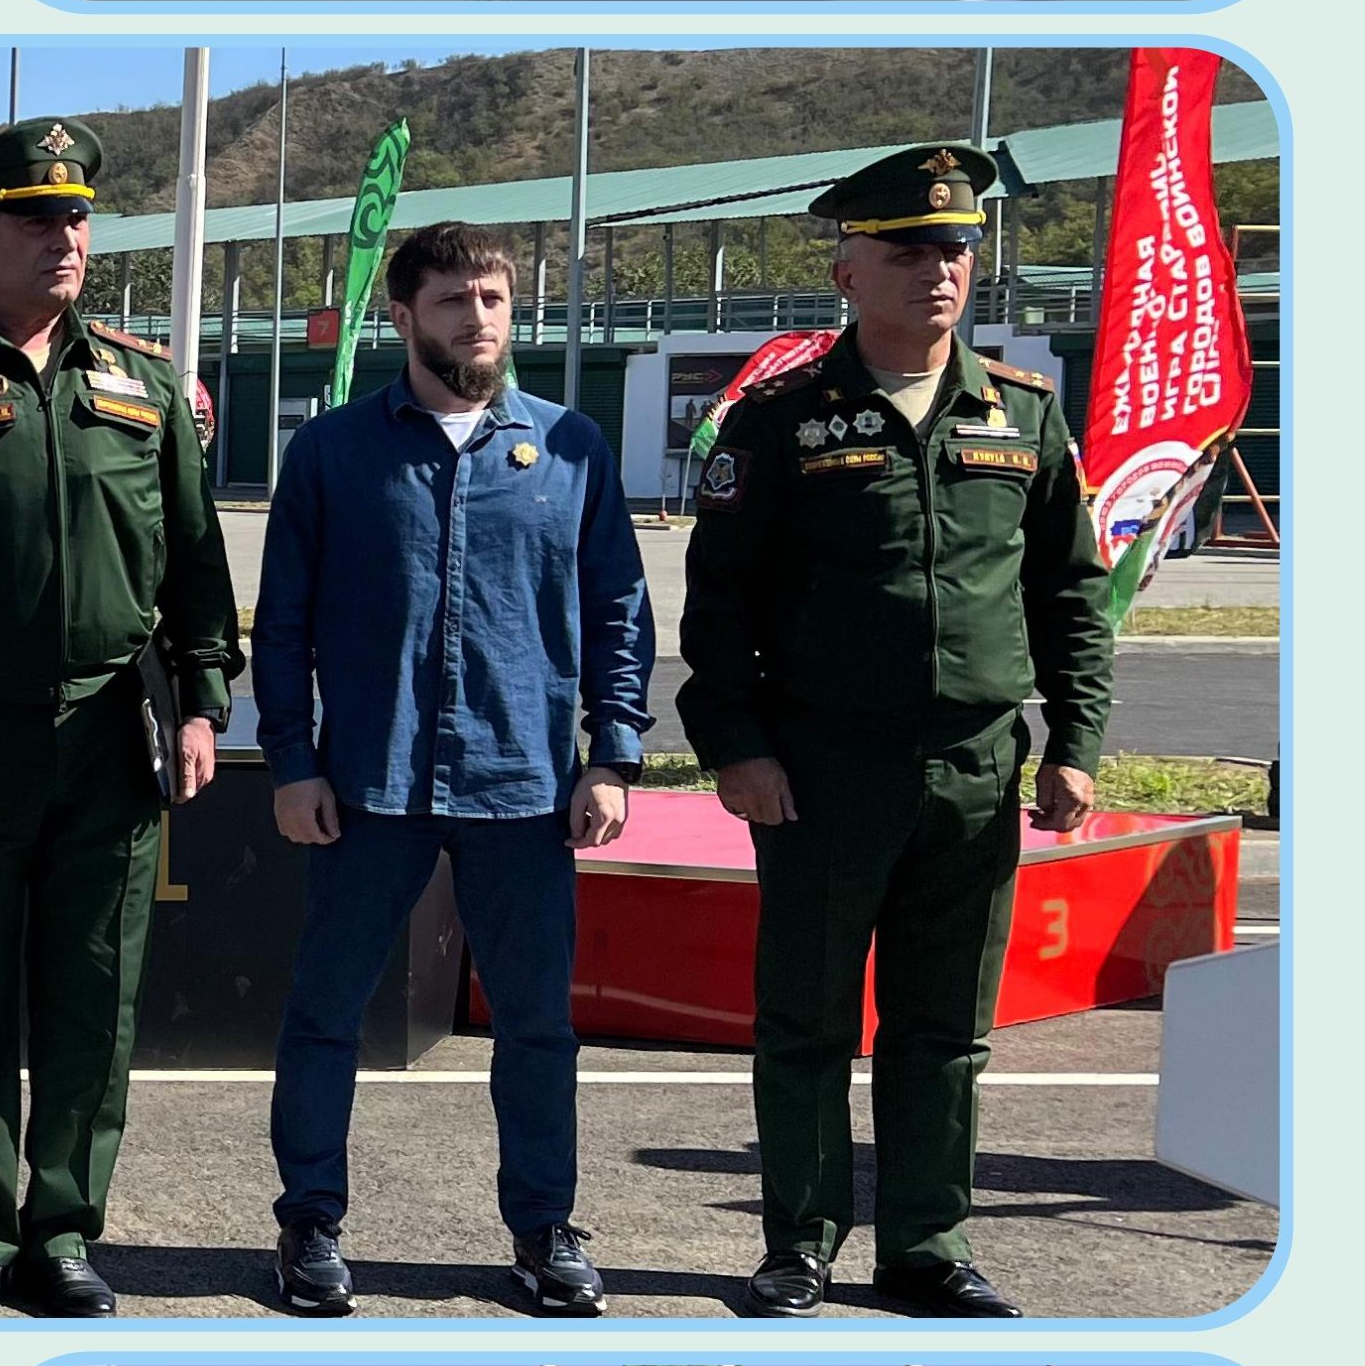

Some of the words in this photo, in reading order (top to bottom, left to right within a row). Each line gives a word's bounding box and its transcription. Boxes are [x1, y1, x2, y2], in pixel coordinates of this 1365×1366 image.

[1161, 330, 1188, 420] ИГРА
[1183, 254, 1212, 415] ГОРОДОВ
[1037, 899, 1069, 960] 3
